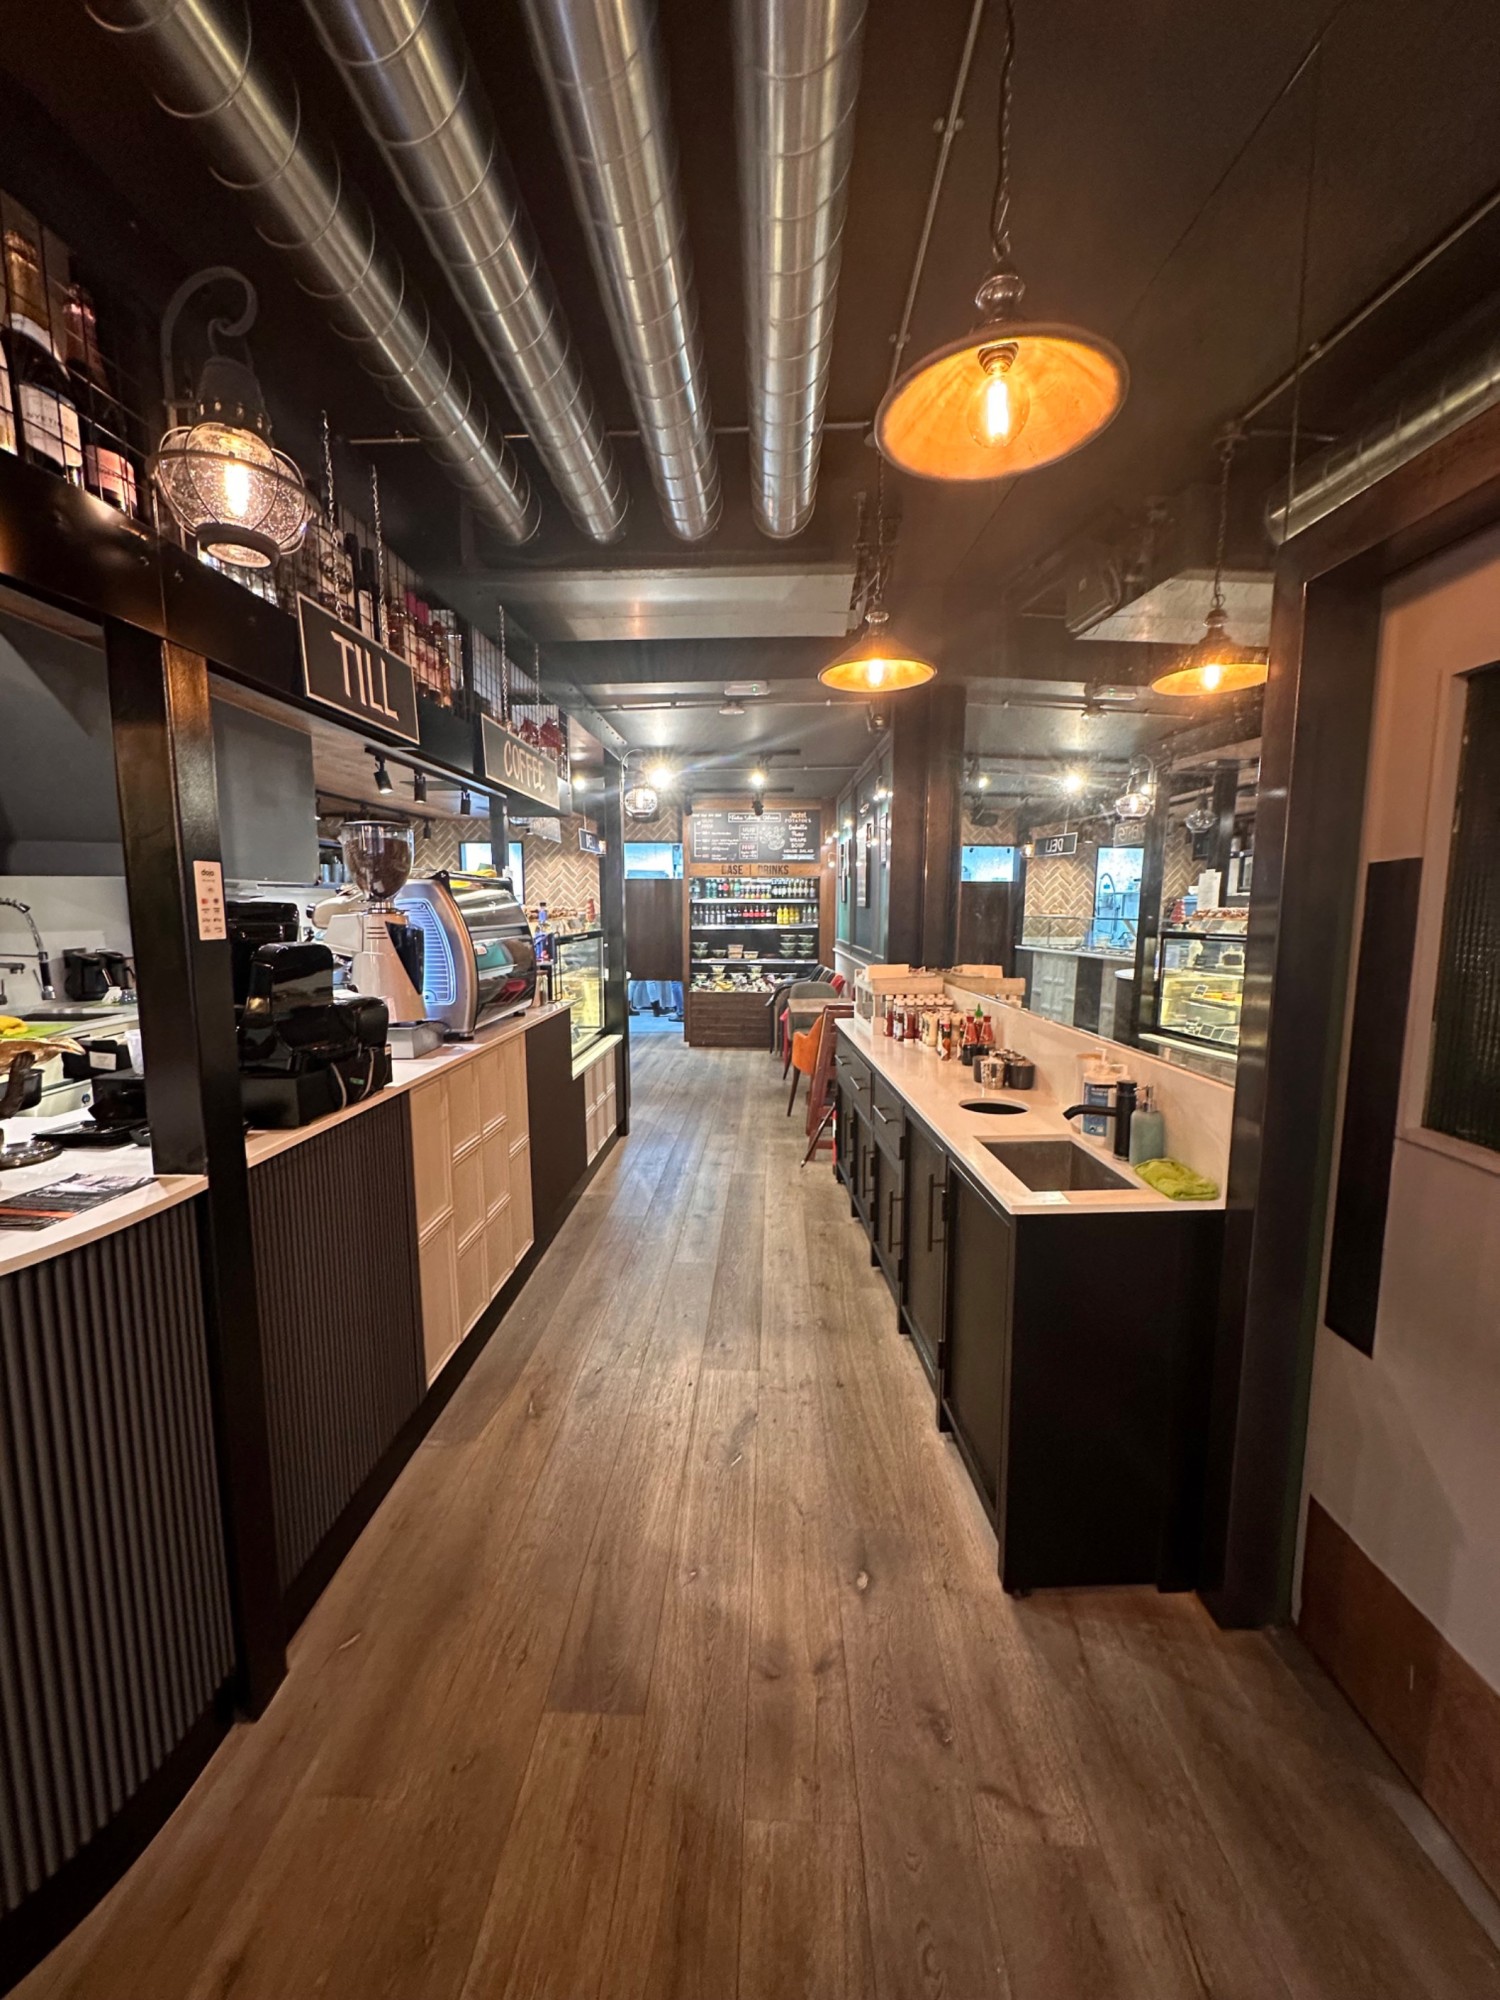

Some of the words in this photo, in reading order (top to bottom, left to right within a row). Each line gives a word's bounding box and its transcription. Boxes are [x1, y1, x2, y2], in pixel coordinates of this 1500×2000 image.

[330, 630, 399, 722] TILL
[503, 740, 546, 793] COFFEE
[201, 869, 215, 877] dojo
